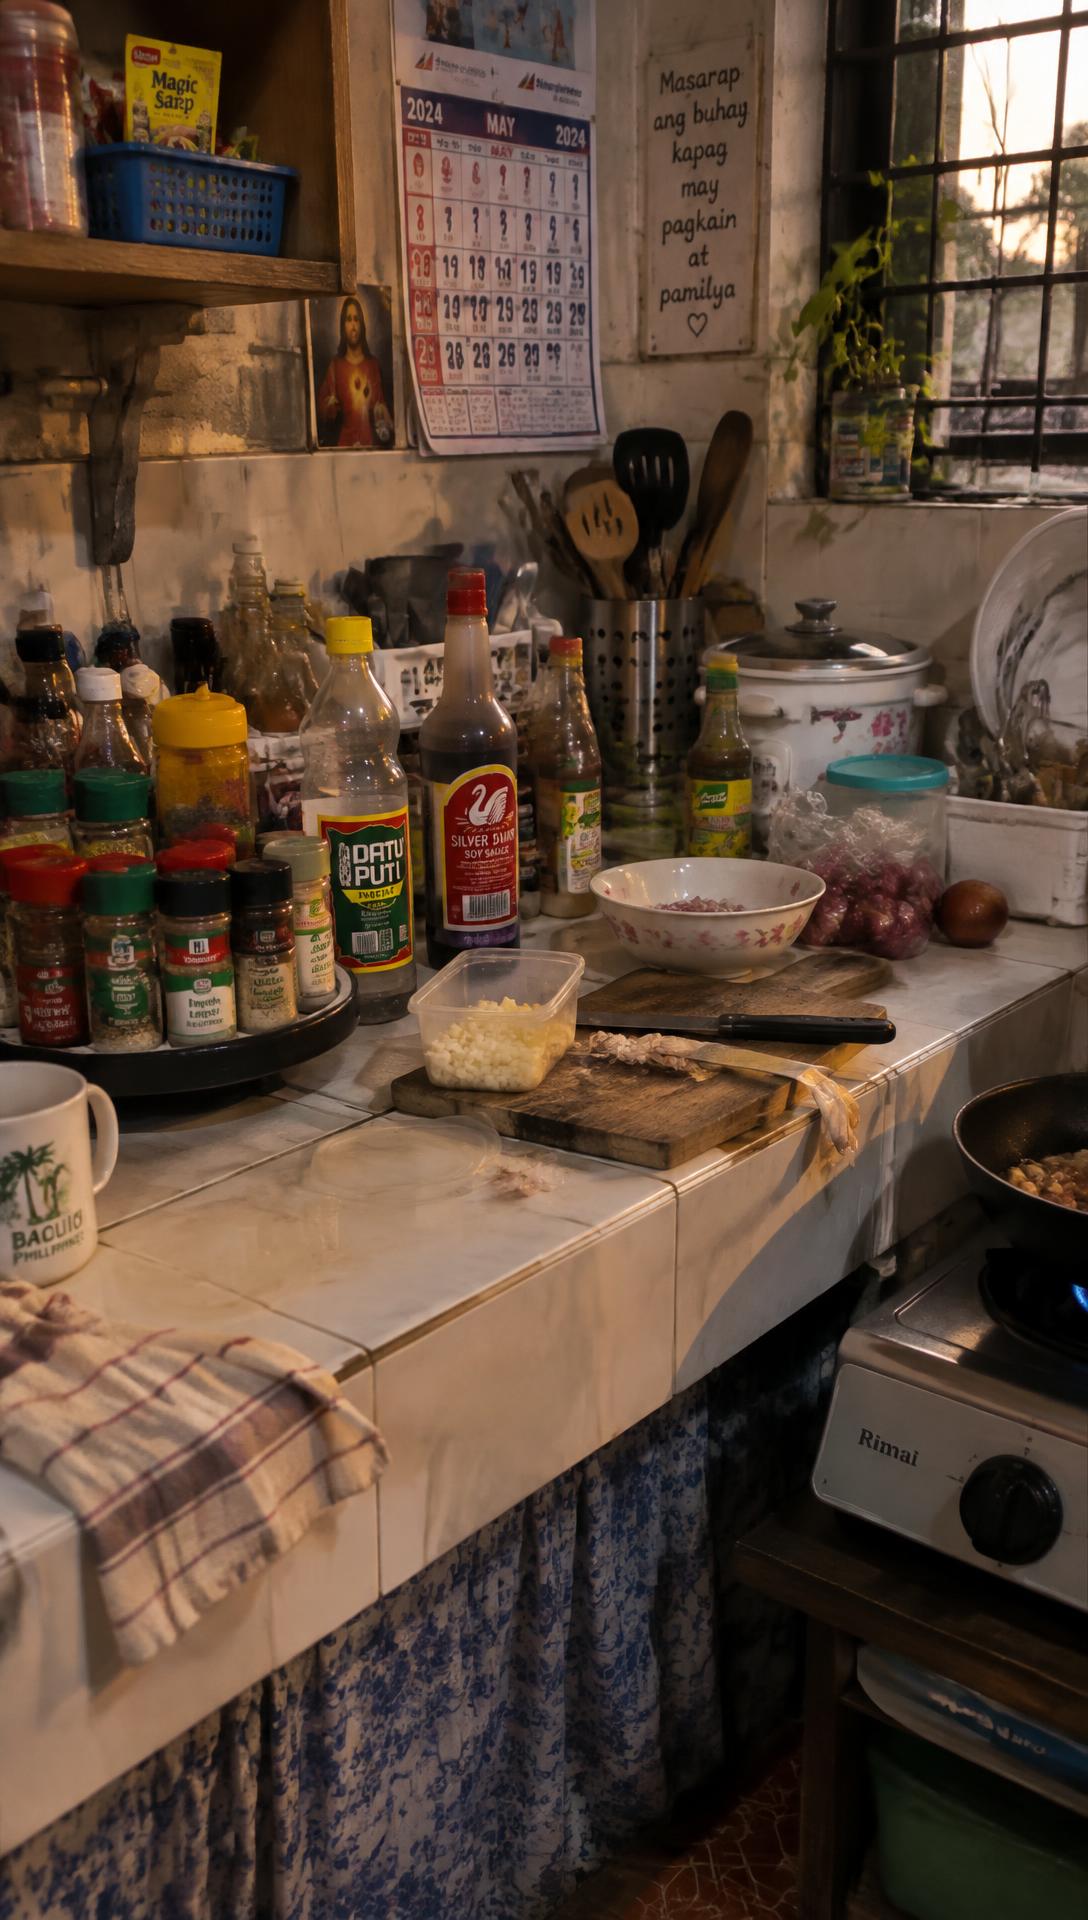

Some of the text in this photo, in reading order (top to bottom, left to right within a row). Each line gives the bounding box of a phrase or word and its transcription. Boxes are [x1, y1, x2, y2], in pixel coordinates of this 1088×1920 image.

[151, 70, 198, 96] Magic
[660, 66, 740, 95] Masarap
[407, 97, 586, 148] 2024 MAY 2024
[653, 97, 748, 136] ang buhay
[672, 140, 728, 170] kapag
[681, 179, 719, 204] may
[662, 208, 737, 246] pagkain
[443, 254, 459, 279] 19
[688, 243, 709, 267] at
[660, 275, 736, 312] pamilya
[451, 834, 489, 849] SILVER
[464, 849, 483, 859] SOY
[355, 860, 400, 887] PUTI
